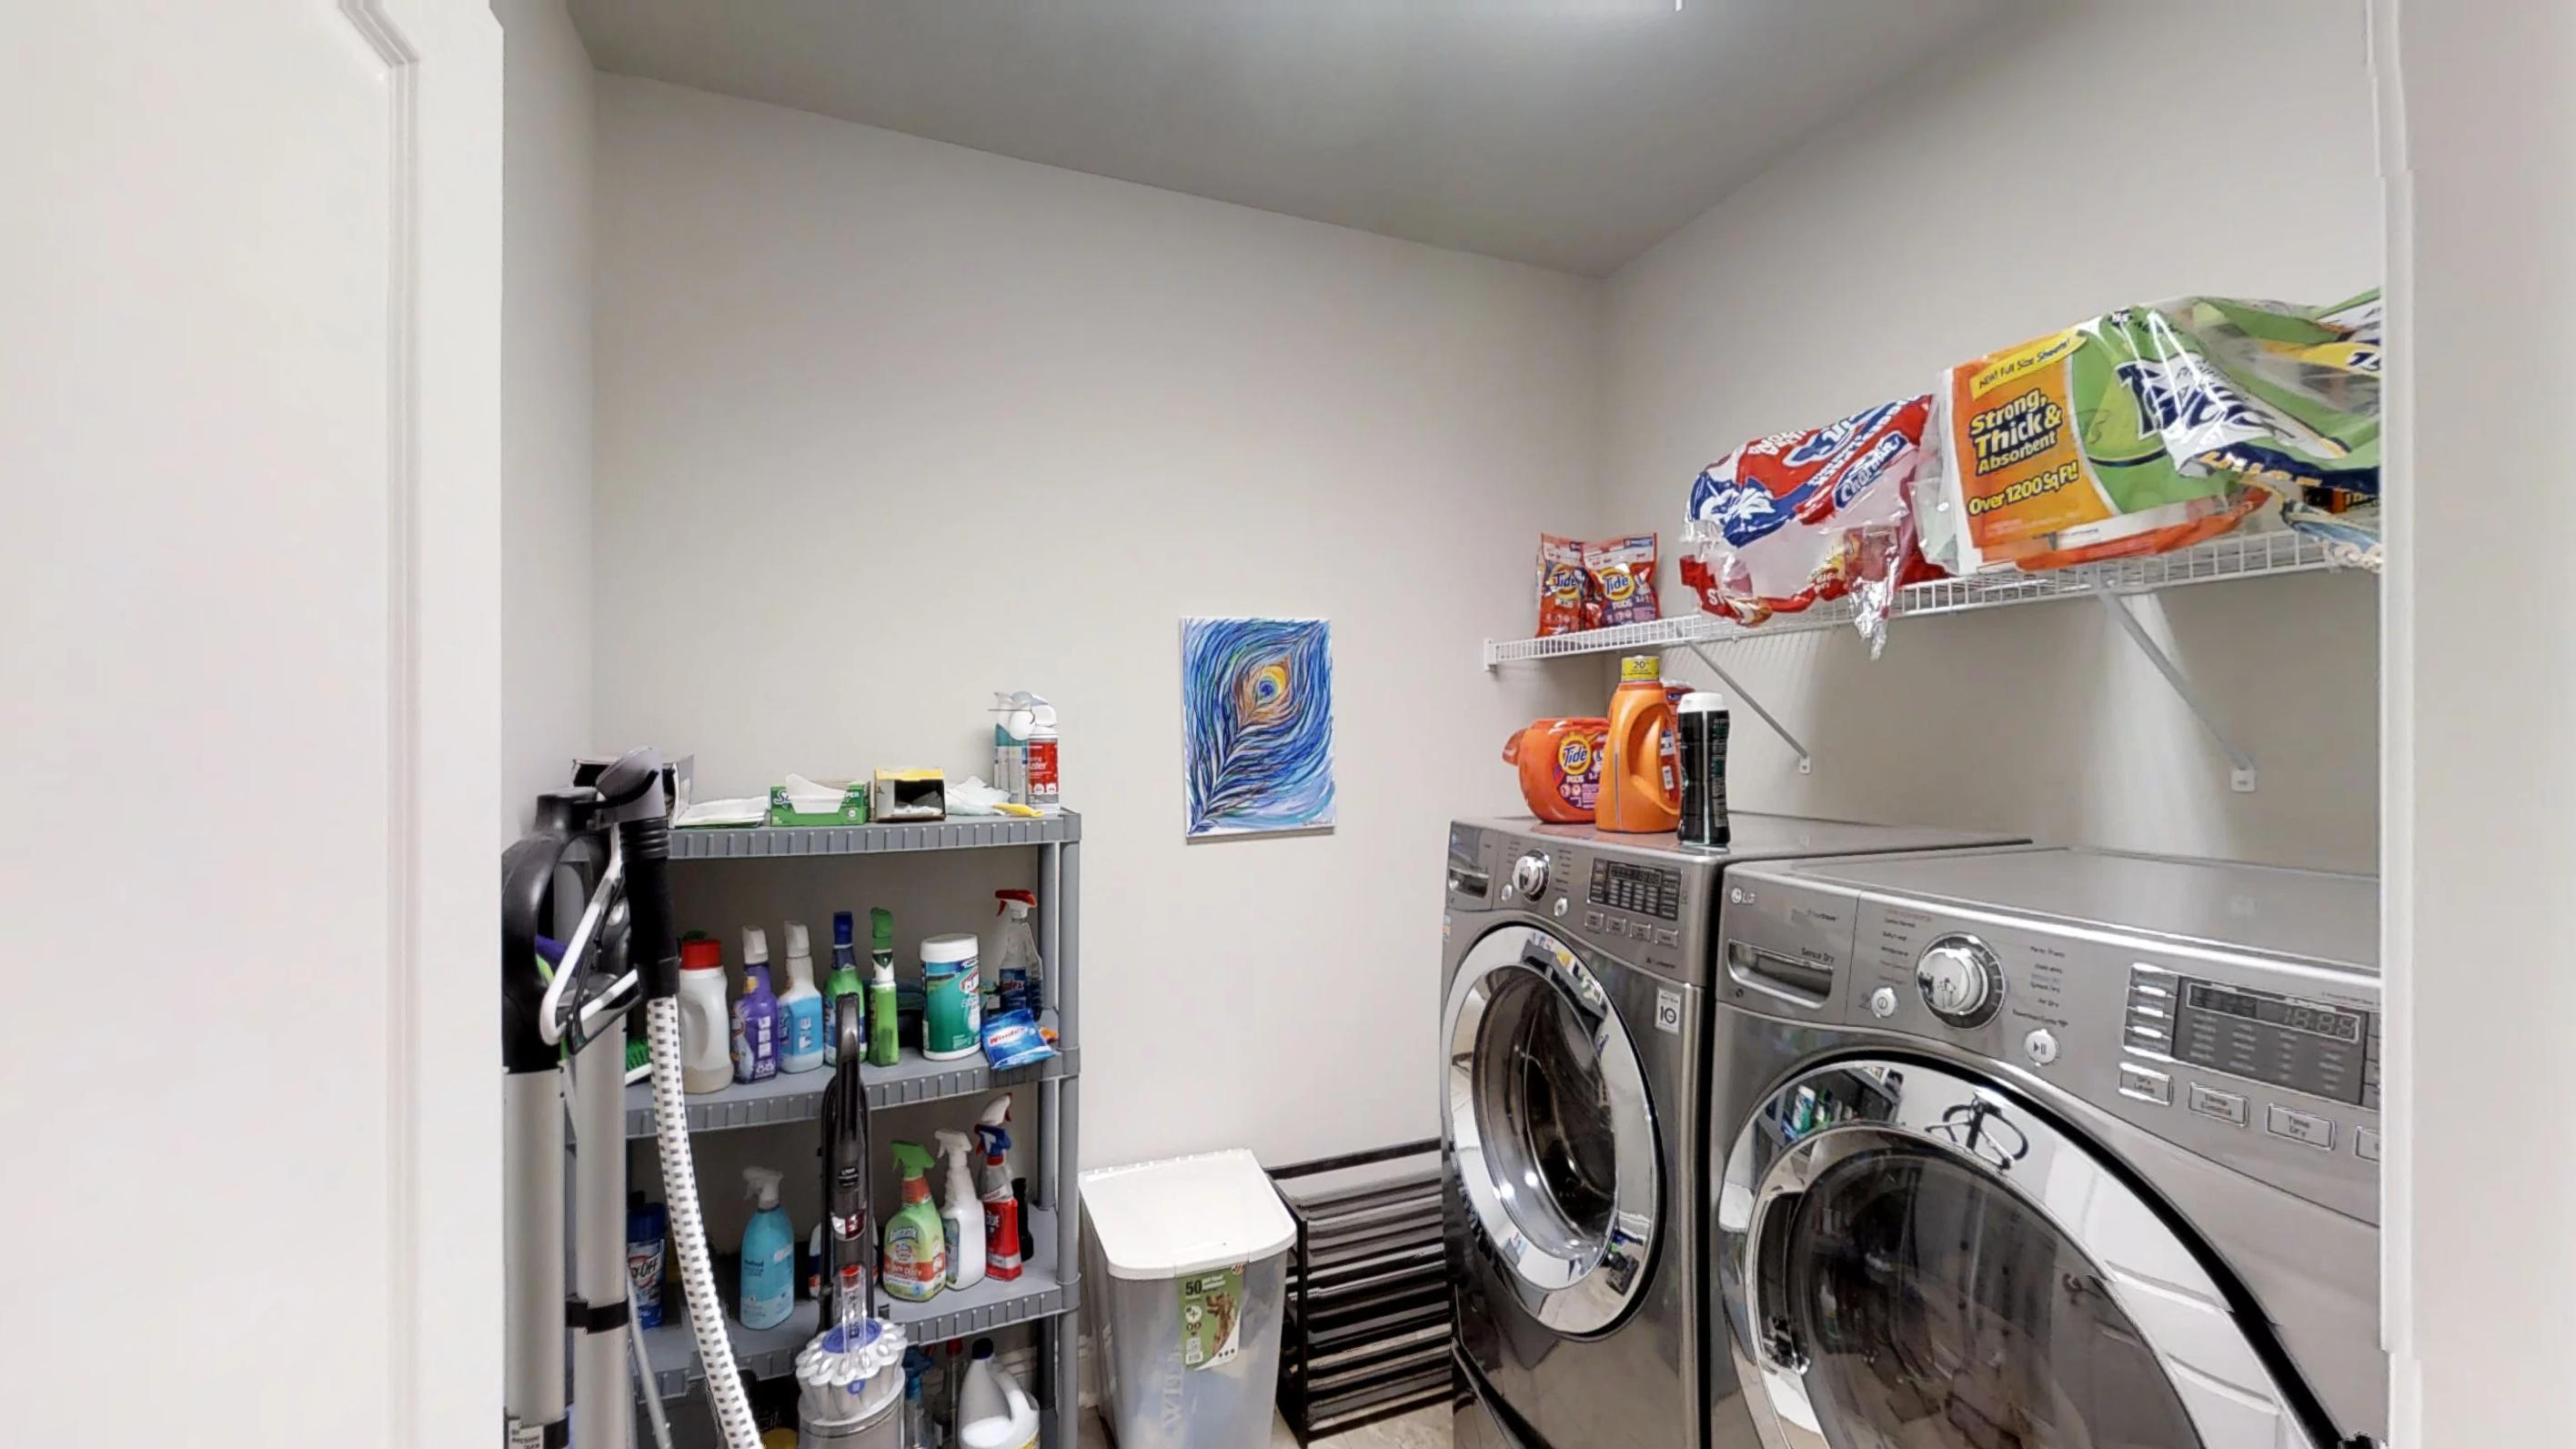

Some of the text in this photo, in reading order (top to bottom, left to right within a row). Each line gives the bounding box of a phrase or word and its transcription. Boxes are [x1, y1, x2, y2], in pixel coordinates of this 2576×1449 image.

[1969, 388, 2048, 436] Strong,
[1973, 403, 2063, 459] Thick &
[1839, 435, 1900, 503] Charmin
[1977, 430, 2058, 476] Absorbent
[1967, 492, 2006, 517] Over
[2005, 477, 2043, 505] 1200
[2042, 472, 2060, 492] Sq
[1554, 571, 1576, 589] Tide
[1602, 576, 1629, 596] Tide
[1563, 745, 1587, 767] Tide
[1823, 951, 1835, 964] Dry
[1185, 1279, 1202, 1296] 50
